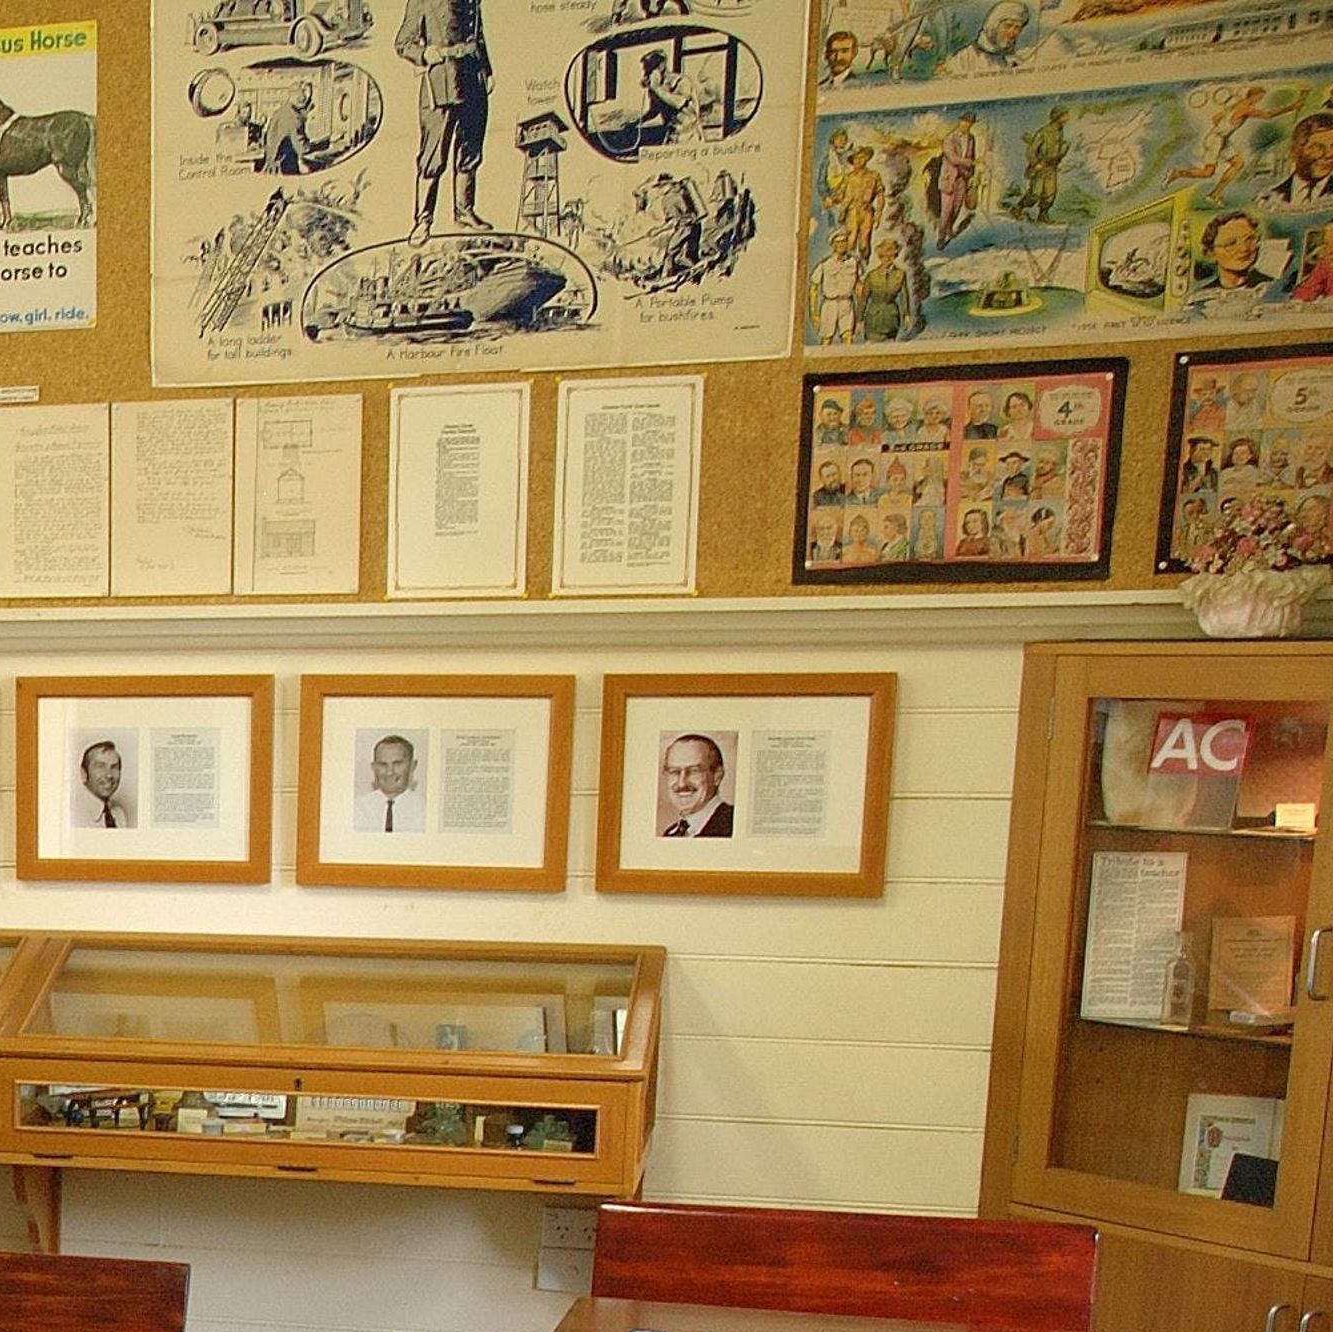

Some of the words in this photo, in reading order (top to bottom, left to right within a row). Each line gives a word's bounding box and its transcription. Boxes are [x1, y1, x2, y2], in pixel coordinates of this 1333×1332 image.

[30, 29, 89, 51] Horse
[640, 145, 699, 163] Reporting
[3, 234, 83, 257] teaches
[48, 262, 68, 279] to
[1149, 717, 1248, 772] AC
